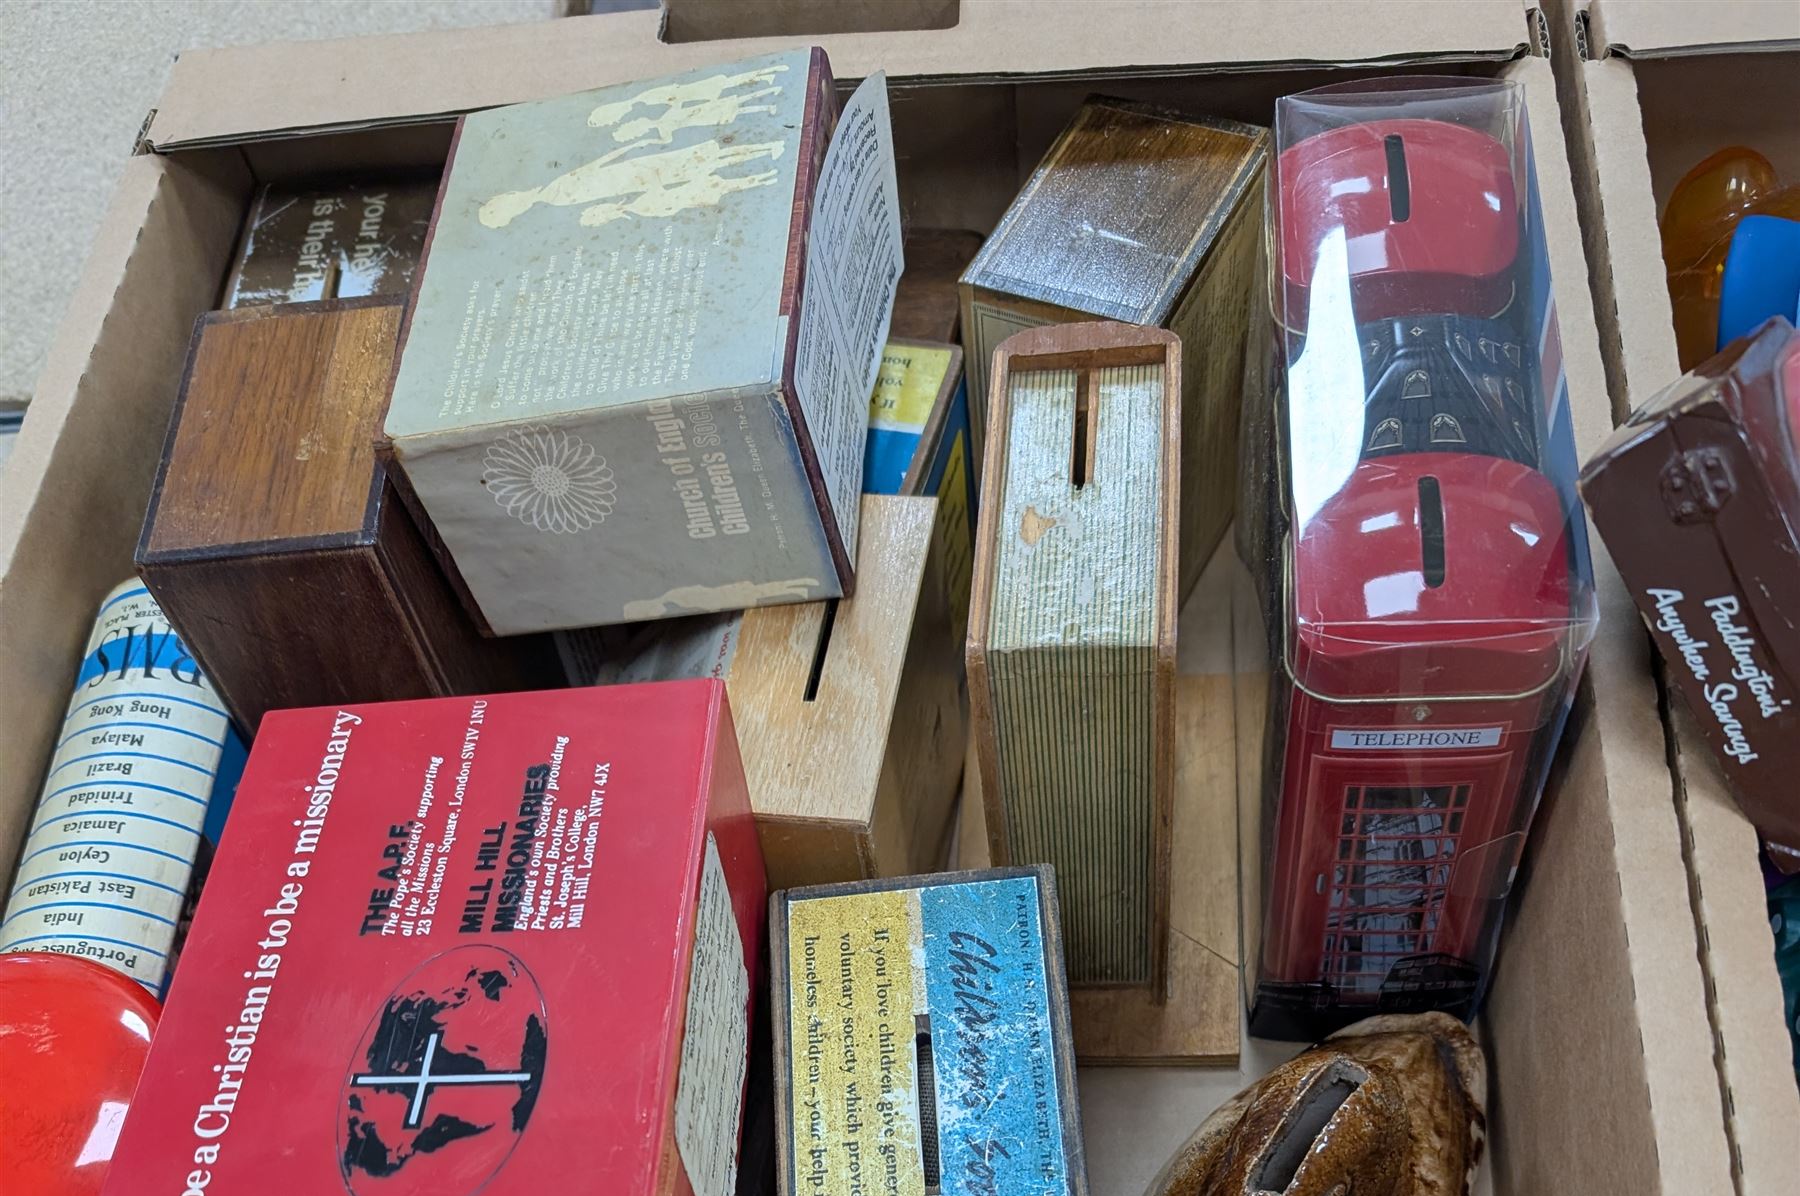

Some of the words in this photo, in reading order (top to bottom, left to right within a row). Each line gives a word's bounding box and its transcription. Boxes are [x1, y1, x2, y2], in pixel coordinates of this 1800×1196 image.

[296, 218, 335, 269] their
[660, 456, 696, 475] of
[673, 479, 718, 538] Church
[700, 451, 751, 535] Children's
[1646, 587, 1712, 684] Anywhen
[1704, 682, 1760, 766] Savings
[1704, 595, 1783, 720] Paddington's
[88, 702, 125, 719] Kong
[129, 702, 172, 720] Hong
[470, 700, 487, 724] 1NU
[91, 732, 144, 747] Malaya
[461, 728, 478, 758] SW1V
[1350, 730, 1482, 748] TELEPHONE
[86, 762, 133, 778] Brazil
[295, 712, 360, 851] missionary
[547, 736, 568, 789] providing
[594, 763, 609, 785] 4JX
[68, 790, 133, 808] Trinidad
[417, 756, 442, 817] supporting
[448, 761, 471, 805] London
[534, 793, 556, 837] Society
[588, 789, 604, 816] NW7
[63, 816, 126, 833] Jamaica
[402, 821, 425, 865] Society
[437, 809, 460, 852] Square,
[546, 808, 567, 859] Brothers
[564, 805, 587, 852] College,
[59, 846, 110, 864] Ceylon
[475, 822, 506, 870] HILL
[493, 765, 547, 931] MISSIONARIES
[531, 841, 544, 866] own
[578, 822, 598, 868] London
[287, 861, 309, 876] a
[410, 843, 434, 892] Missions
[421, 857, 447, 914] Eccleston
[544, 863, 557, 886] and
[554, 855, 576, 907] Joseph's
[572, 873, 590, 899] Hill,
[28, 880, 91, 898] Pakistan
[98, 881, 135, 898] East
[264, 883, 302, 915] be
[389, 869, 410, 908] Pope's
[405, 897, 420, 916] the
[459, 878, 492, 932] MILL
[513, 870, 538, 929] England's
[43, 912, 83, 925] India
[360, 888, 392, 934] THE
[381, 912, 399, 935] The
[400, 920, 414, 936] all
[416, 919, 431, 934] 23
[531, 889, 551, 929] Priests
[549, 911, 565, 928] St.
[567, 904, 583, 927] Mill
[258, 919, 290, 948] to
[873, 927, 888, 944] If
[244, 954, 280, 979] is
[803, 934, 823, 1008] homeless
[833, 932, 856, 1010] voluntary
[868, 947, 888, 978] you
[875, 982, 892, 1018] love
[195, 987, 269, 1137] Christian
[837, 1016, 857, 1075] society
[877, 1022, 897, 1094] children
[806, 1099, 824, 1141] your
[843, 1081, 862, 1134] which
[875, 1100, 899, 1138] give
[194, 1143, 219, 1163] a
[807, 1147, 828, 1188] help
